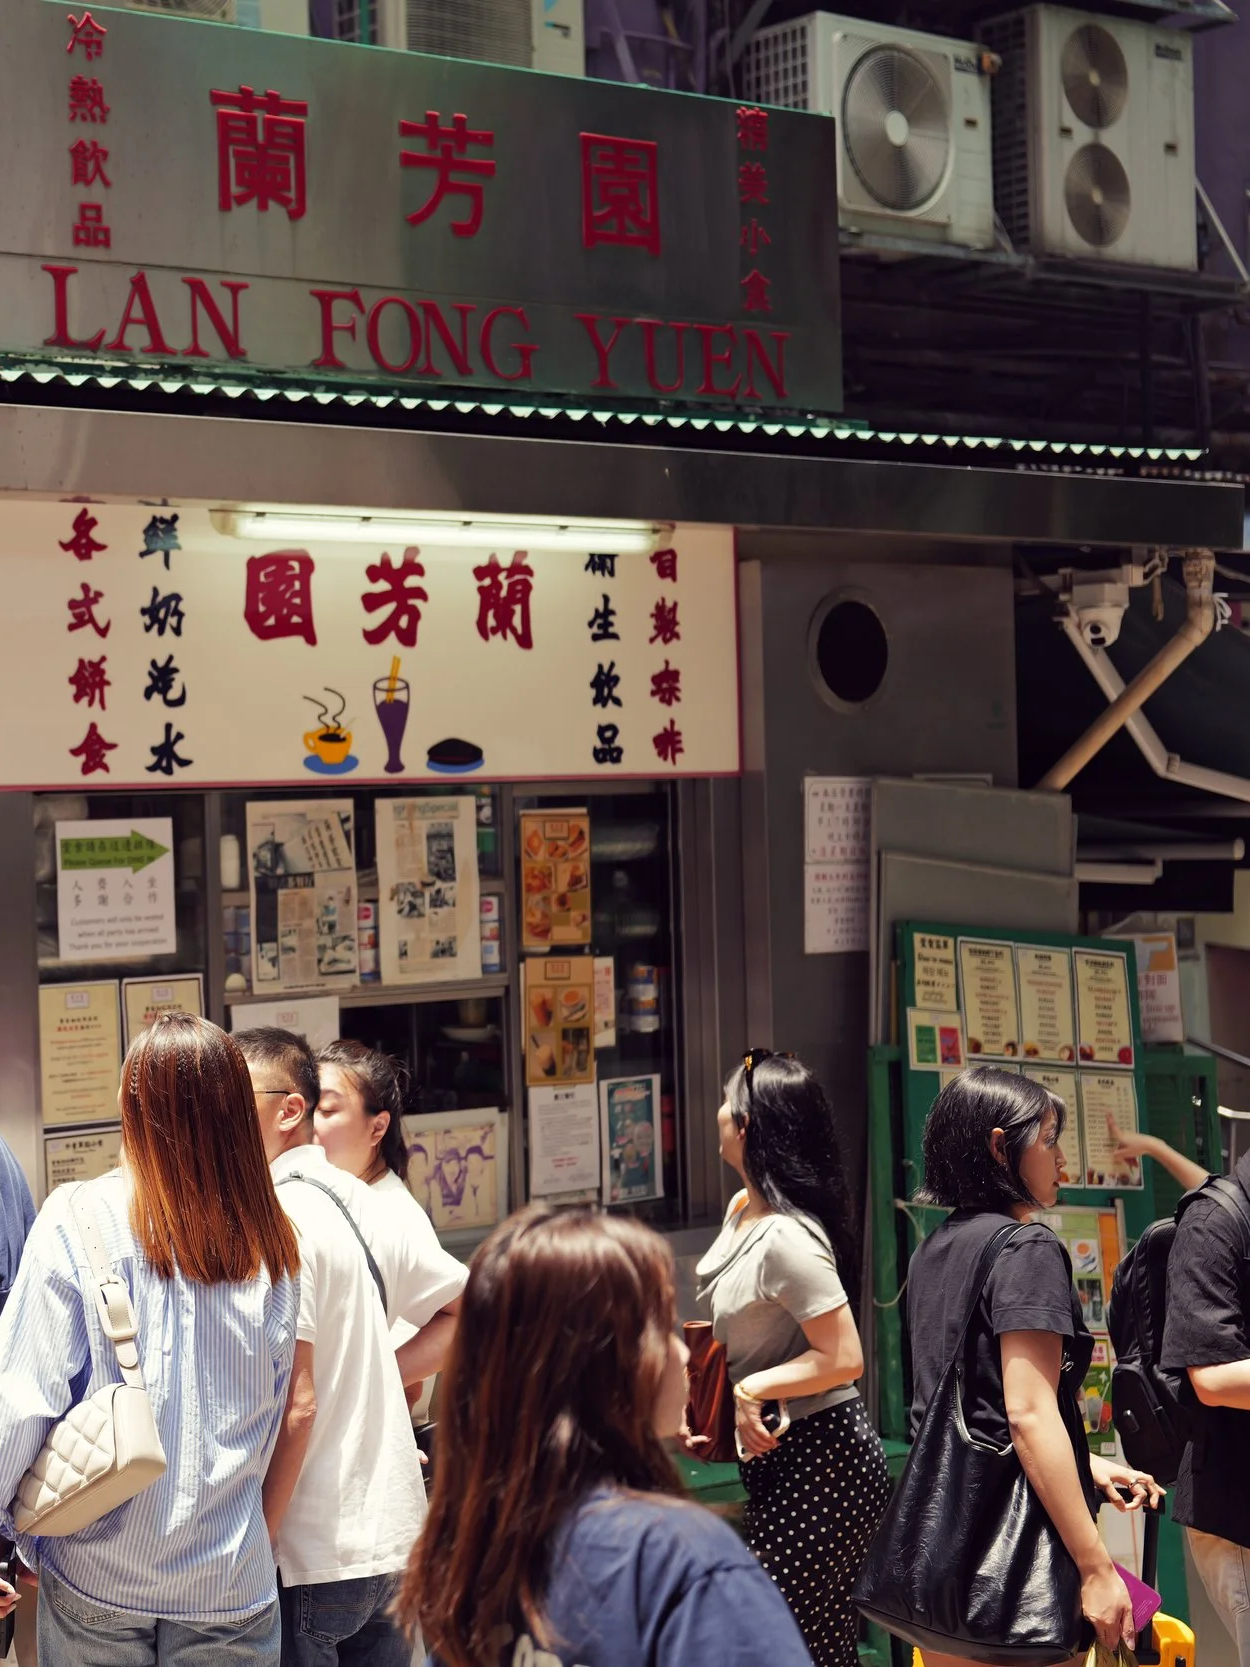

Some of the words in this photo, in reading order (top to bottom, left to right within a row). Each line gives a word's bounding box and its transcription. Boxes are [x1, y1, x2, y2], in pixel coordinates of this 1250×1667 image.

[67, 11, 112, 250] 冷熱飲品
[209, 84, 661, 256] 蘭芳園
[736, 106, 773, 312] 精美小食
[41, 263, 249, 358] LAN
[309, 287, 540, 383] FONG
[574, 313, 792, 401] YUEN
[59, 507, 118, 776] 各式餅食
